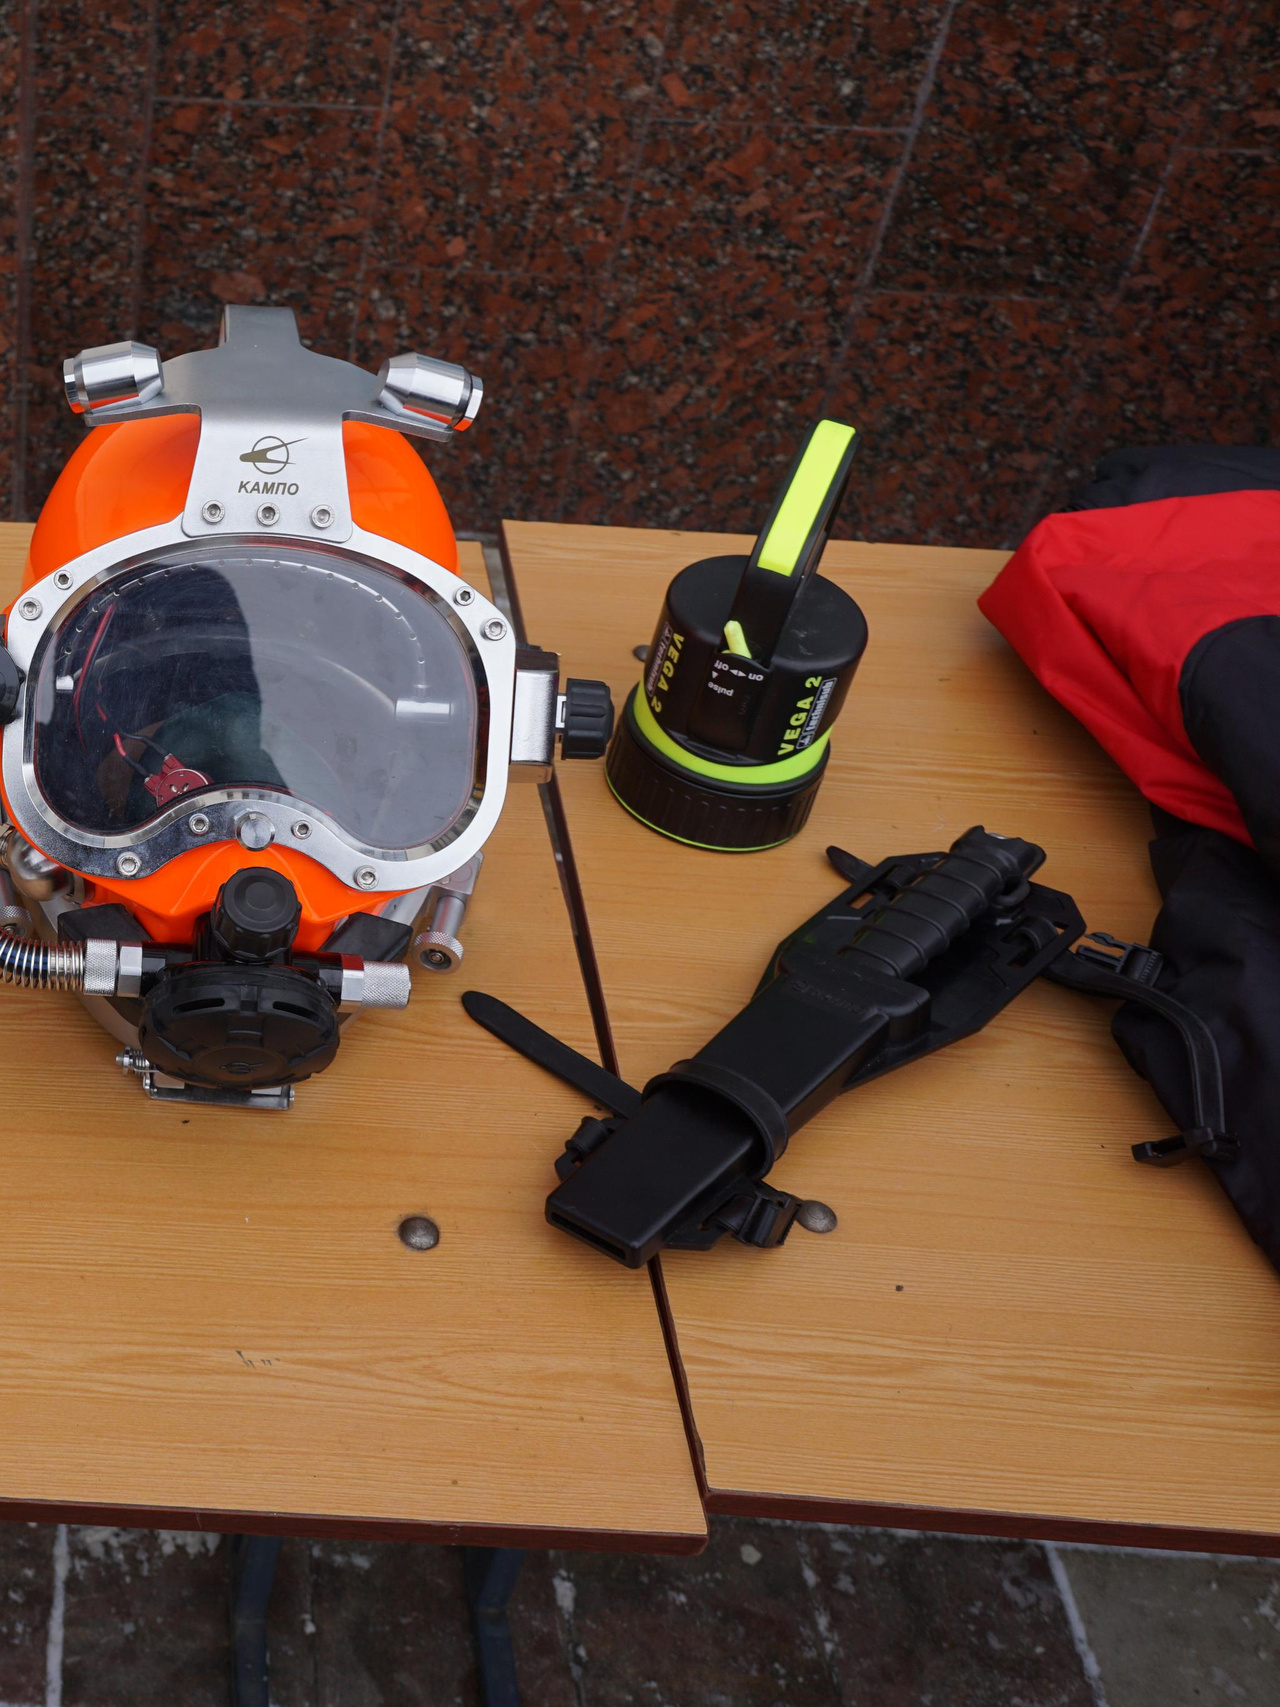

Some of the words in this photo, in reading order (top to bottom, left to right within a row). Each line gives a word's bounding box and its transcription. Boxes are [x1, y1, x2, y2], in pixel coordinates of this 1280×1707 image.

[238, 480, 299, 496] КАМПО
[657, 632, 685, 691] VEGA
[713, 659, 729, 671] off
[748, 673, 764, 682] on
[707, 681, 734, 697] pulse
[650, 695, 663, 713] 2
[776, 695, 815, 756] VEGA
[805, 675, 823, 689] 2
